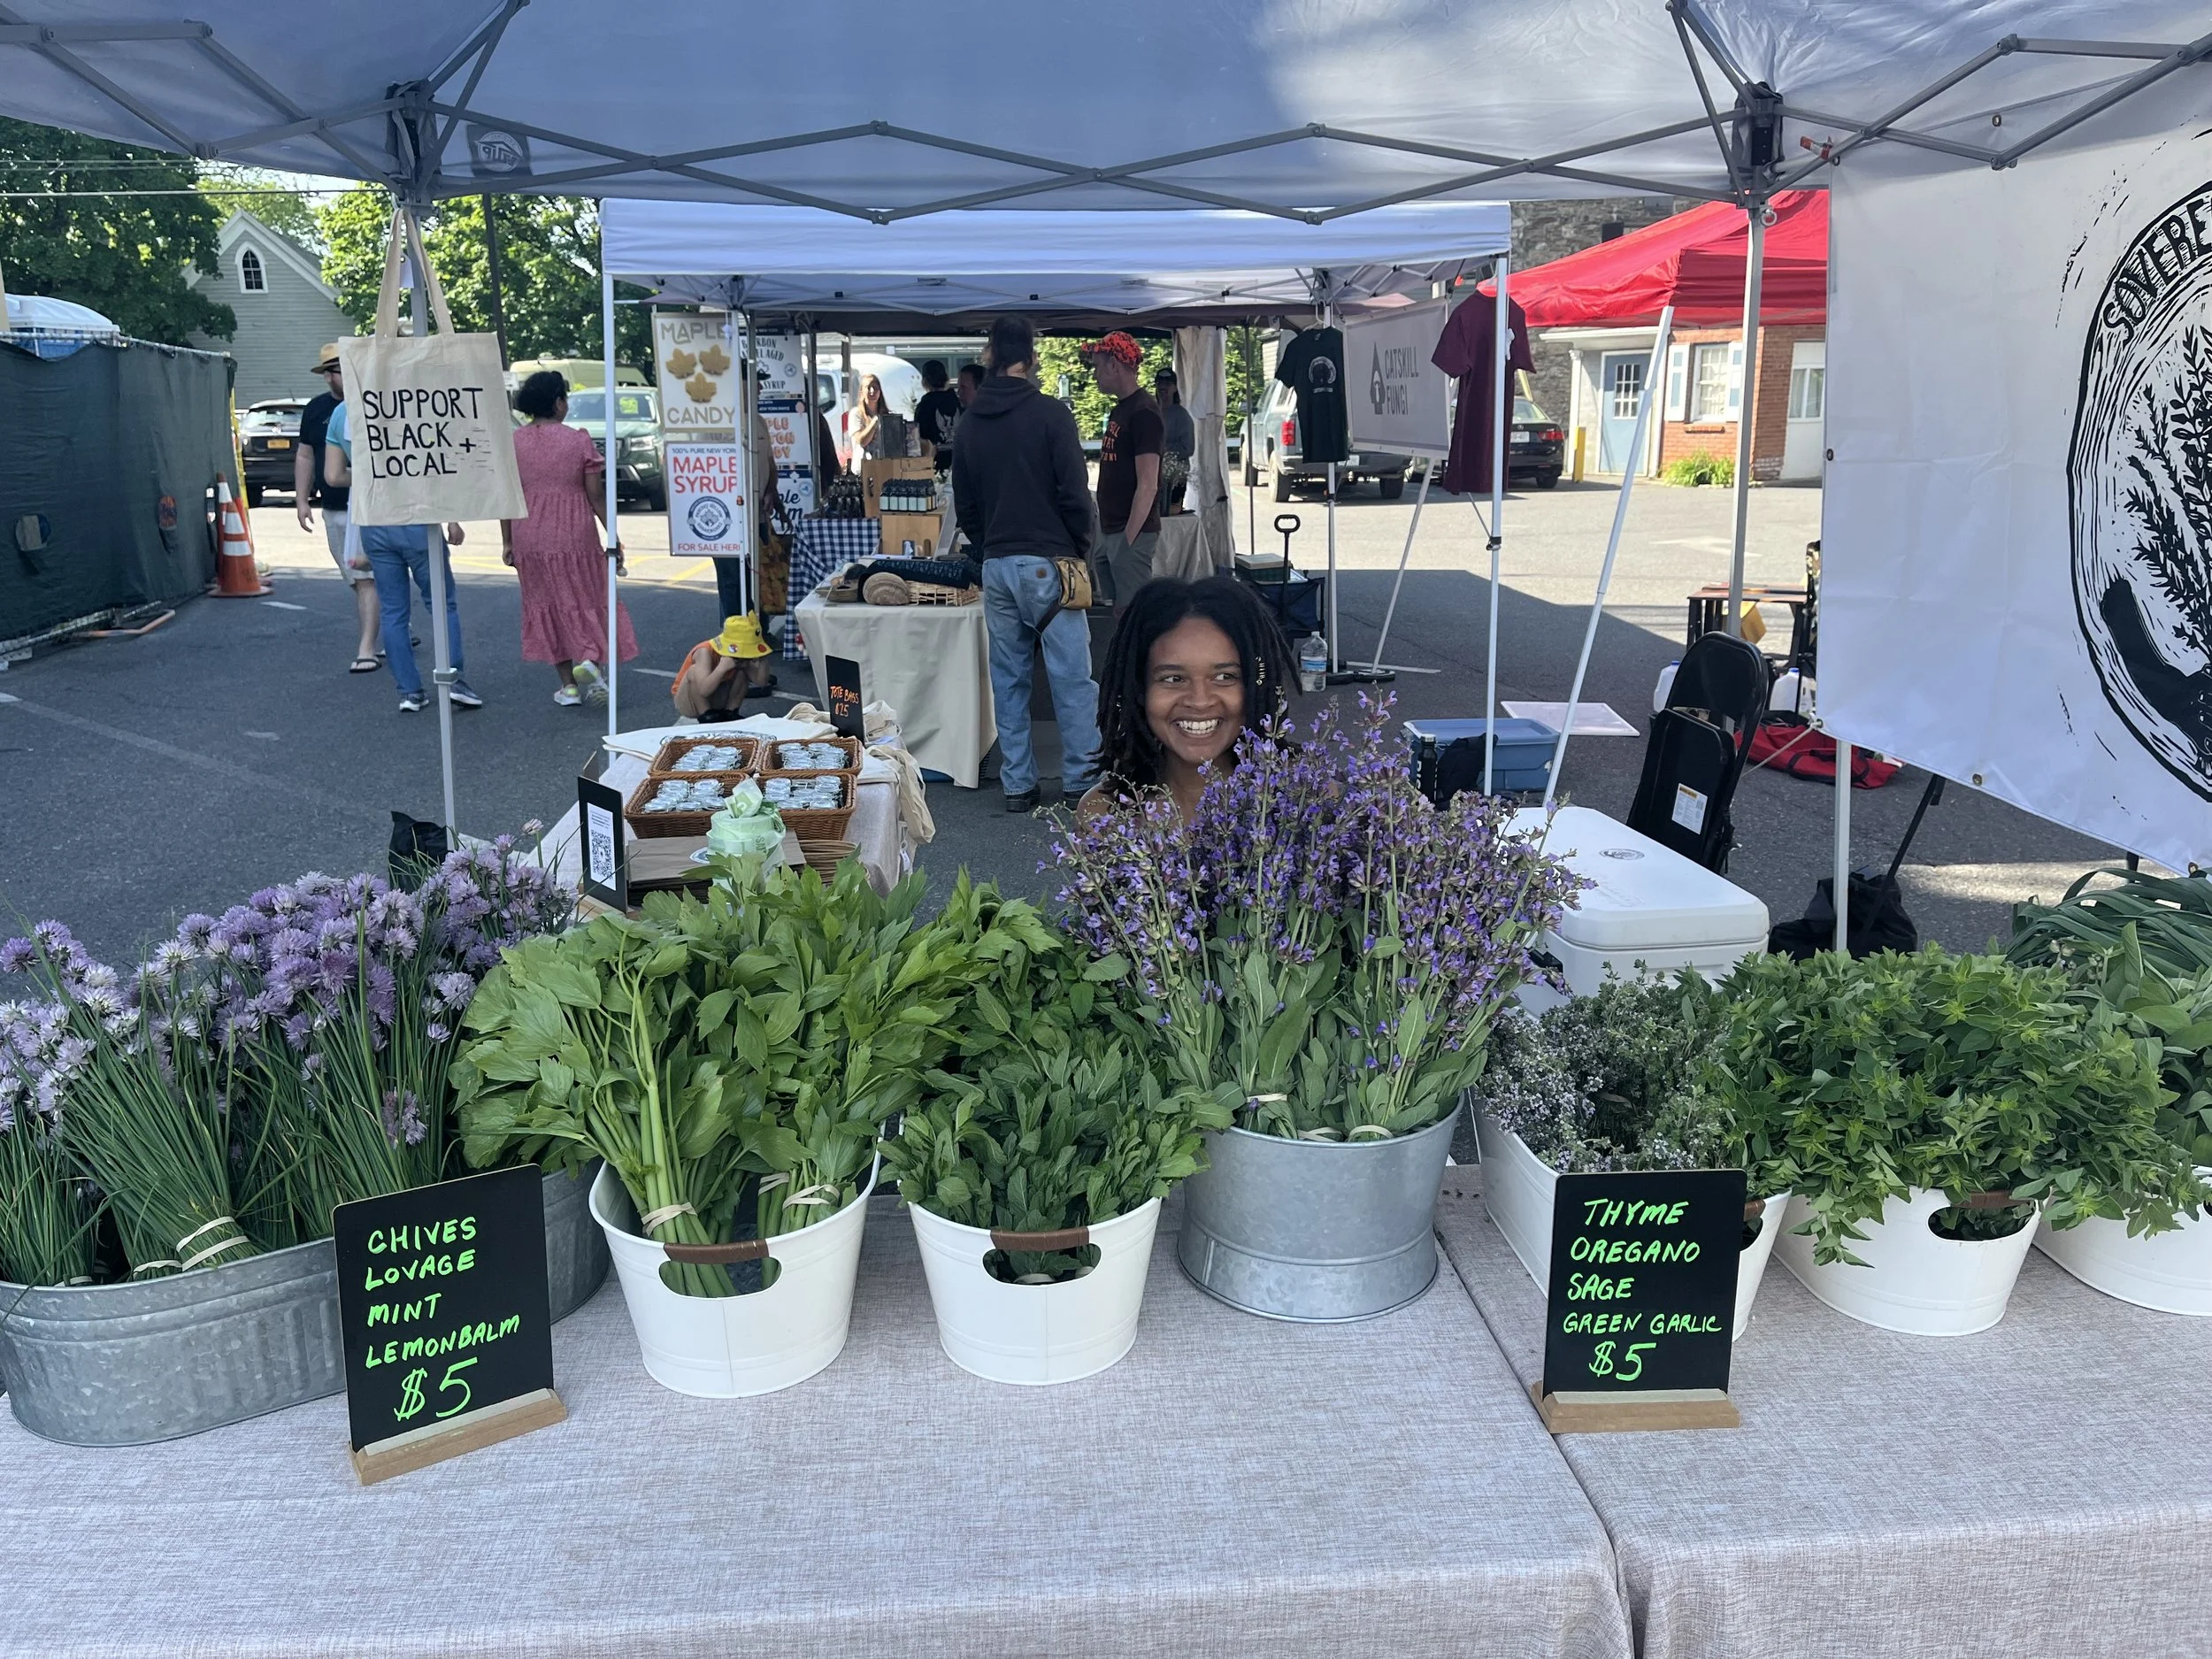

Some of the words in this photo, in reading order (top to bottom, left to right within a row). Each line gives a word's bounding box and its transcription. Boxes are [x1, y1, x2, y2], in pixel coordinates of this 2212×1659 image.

[2103, 196, 2212, 351] SOVERE
[661, 322, 727, 344] MAPLE
[766, 349, 785, 362] AGED
[1385, 346, 1419, 379] CATSKILL
[764, 380, 786, 389] SYRUP
[363, 388, 483, 419] SUPPORT
[1386, 384, 1409, 415] FUNGI
[667, 407, 735, 424] CANDY
[766, 417, 789, 430] PLE
[367, 422, 452, 451] BLACK
[372, 451, 457, 478] LOCAL
[672, 456, 736, 473] MAPLE
[830, 686, 843, 699] TOTE
[1584, 1198, 1689, 1227] THYME
[368, 1216, 477, 1255] CHIVES
[1571, 1236, 1701, 1263] OREGANO
[365, 1248, 476, 1291] LOVAGE
[1567, 1272, 1635, 1301] SAGE
[367, 1293, 442, 1327] MINT
[1563, 1312, 1642, 1334] GREEN
[1649, 1313, 1722, 1334] GARLIC
[365, 1314, 520, 1369] LEMONBALM
[1588, 1340, 1657, 1381] $5
[394, 1356, 478, 1422] $5
